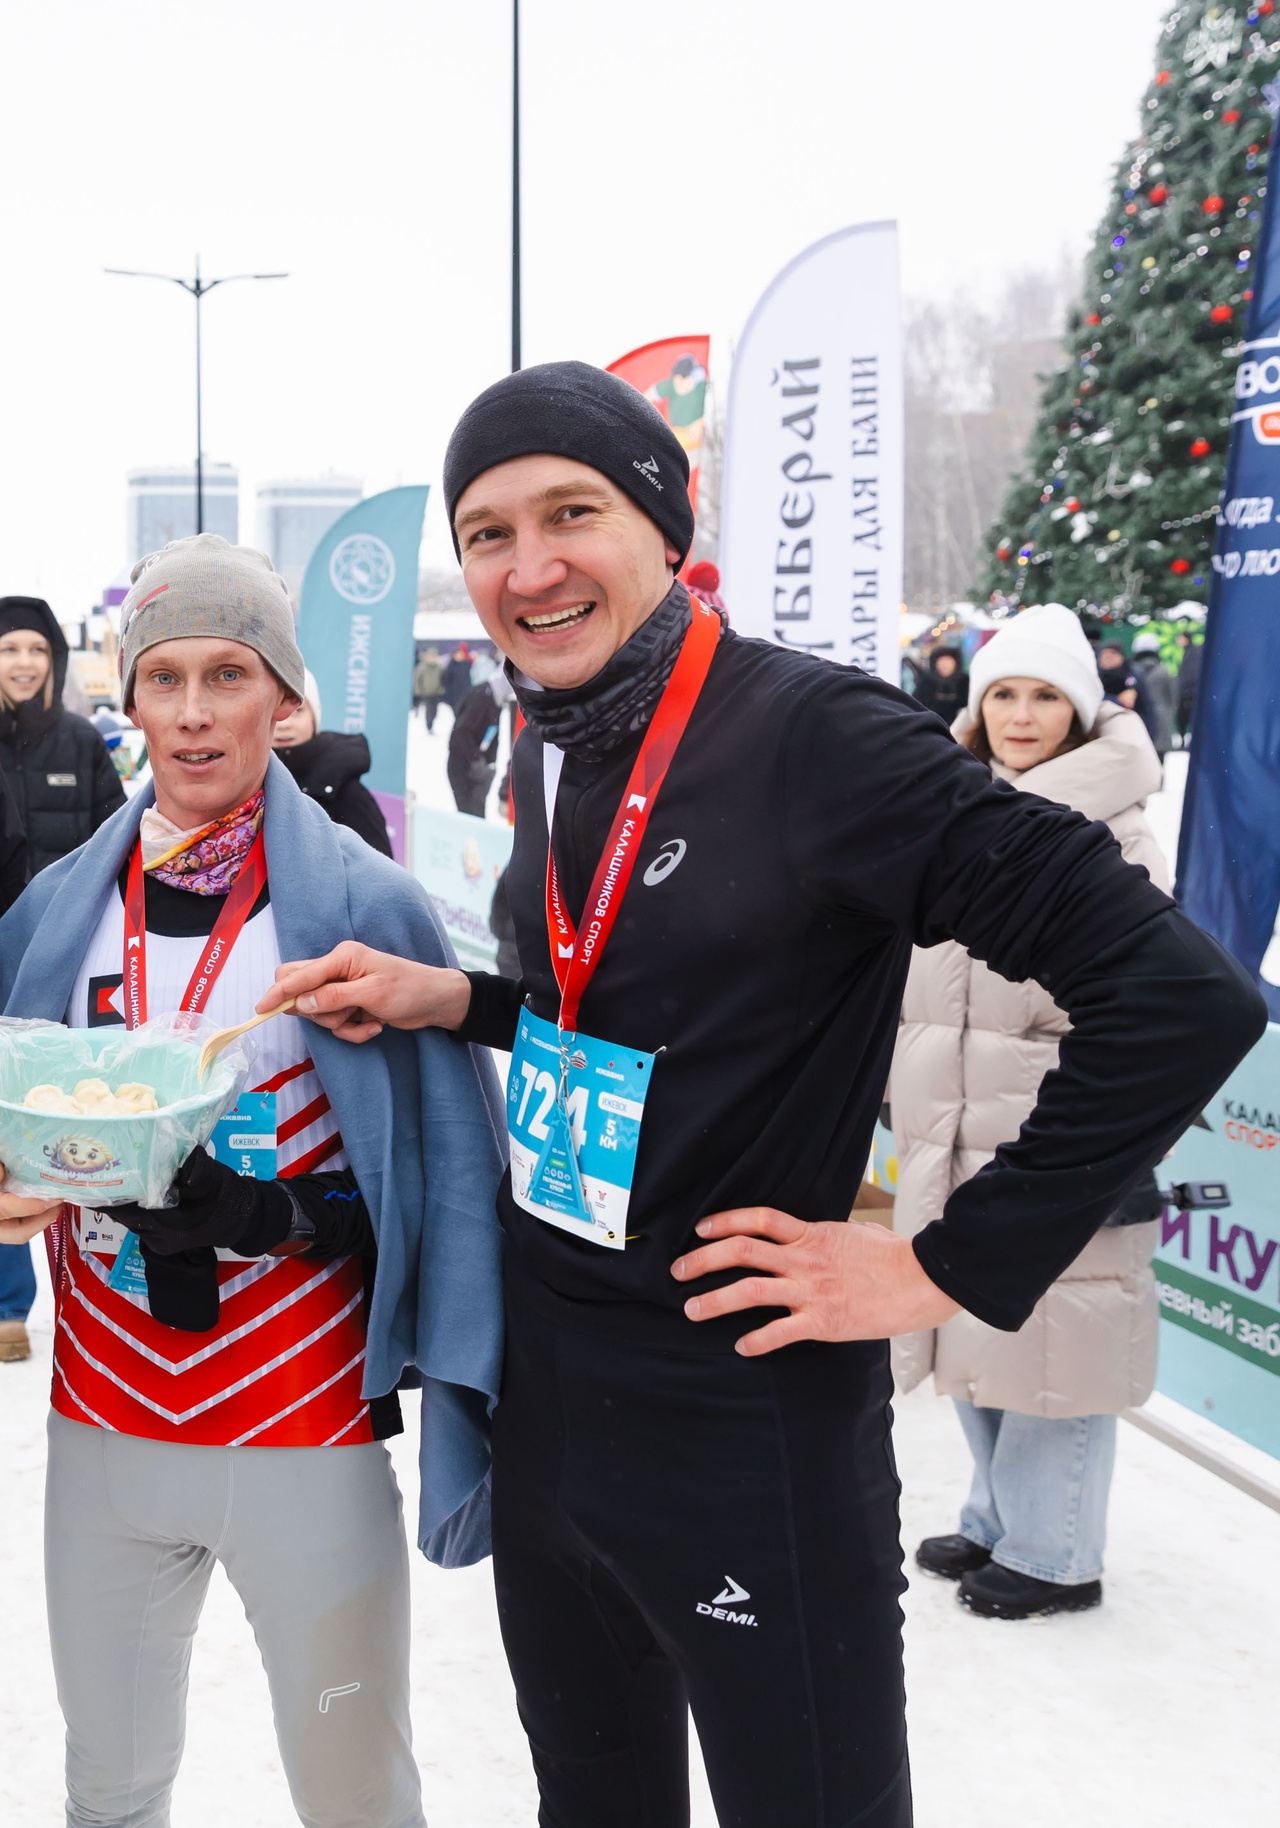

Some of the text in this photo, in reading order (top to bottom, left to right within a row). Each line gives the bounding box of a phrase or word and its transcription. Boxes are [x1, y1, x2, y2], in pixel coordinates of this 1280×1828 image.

[852, 356, 878, 457] БАНИ
[632, 460, 664, 491] DEMIX
[854, 477, 883, 551] ДЛЯ
[581, 819, 635, 966] КАЛАШНИКОВ СПОРТ
[204, 937, 226, 975] СПОРТ
[516, 1060, 590, 1156] 724
[602, 1097, 628, 1112] ИЖЕВСК
[232, 1138, 261, 1146] ИЖЕВСК
[599, 1134, 618, 1151] КМ
[606, 1119, 617, 1136] 5
[241, 1155, 252, 1169] 5
